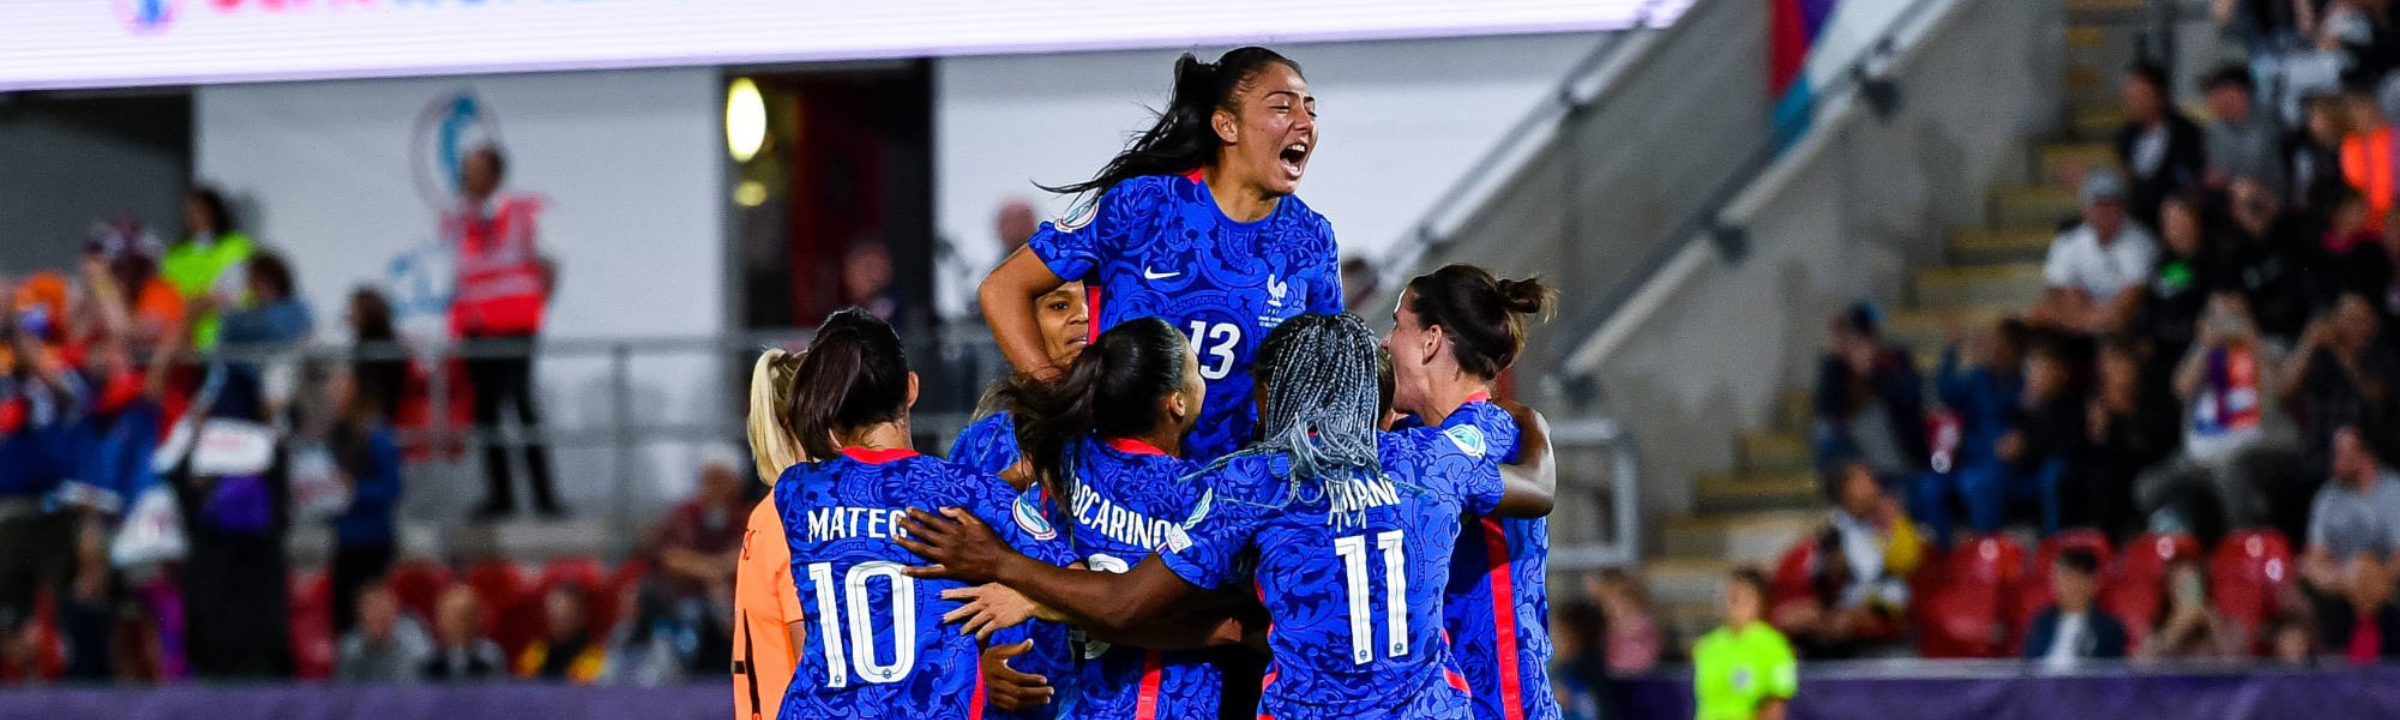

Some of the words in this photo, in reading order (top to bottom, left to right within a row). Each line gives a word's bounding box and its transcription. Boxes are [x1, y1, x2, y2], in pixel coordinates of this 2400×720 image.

[1190, 320, 1241, 380] 13
[1071, 476, 1172, 550] ASCARINO
[808, 560, 916, 688] 10
[1334, 529, 1408, 665] 11
